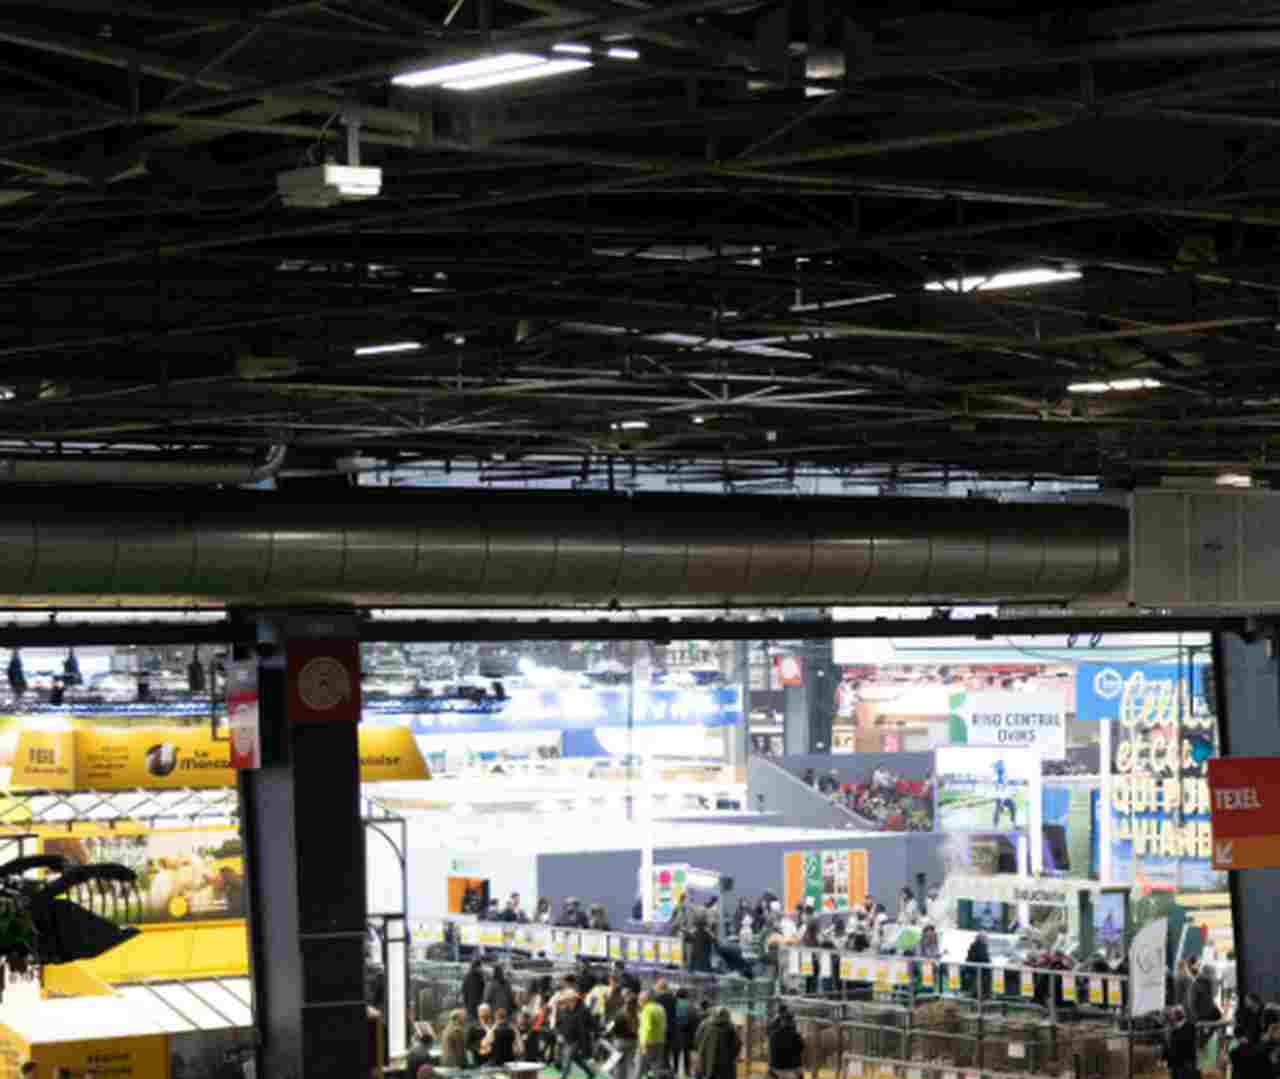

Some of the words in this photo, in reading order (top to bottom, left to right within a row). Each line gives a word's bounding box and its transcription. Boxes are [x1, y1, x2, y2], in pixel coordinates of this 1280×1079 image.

[971, 713, 1001, 727] RING
[1005, 713, 1061, 727] CENTRAL
[998, 729, 1036, 743] OVINS
[1215, 788, 1262, 810] TEXEL
